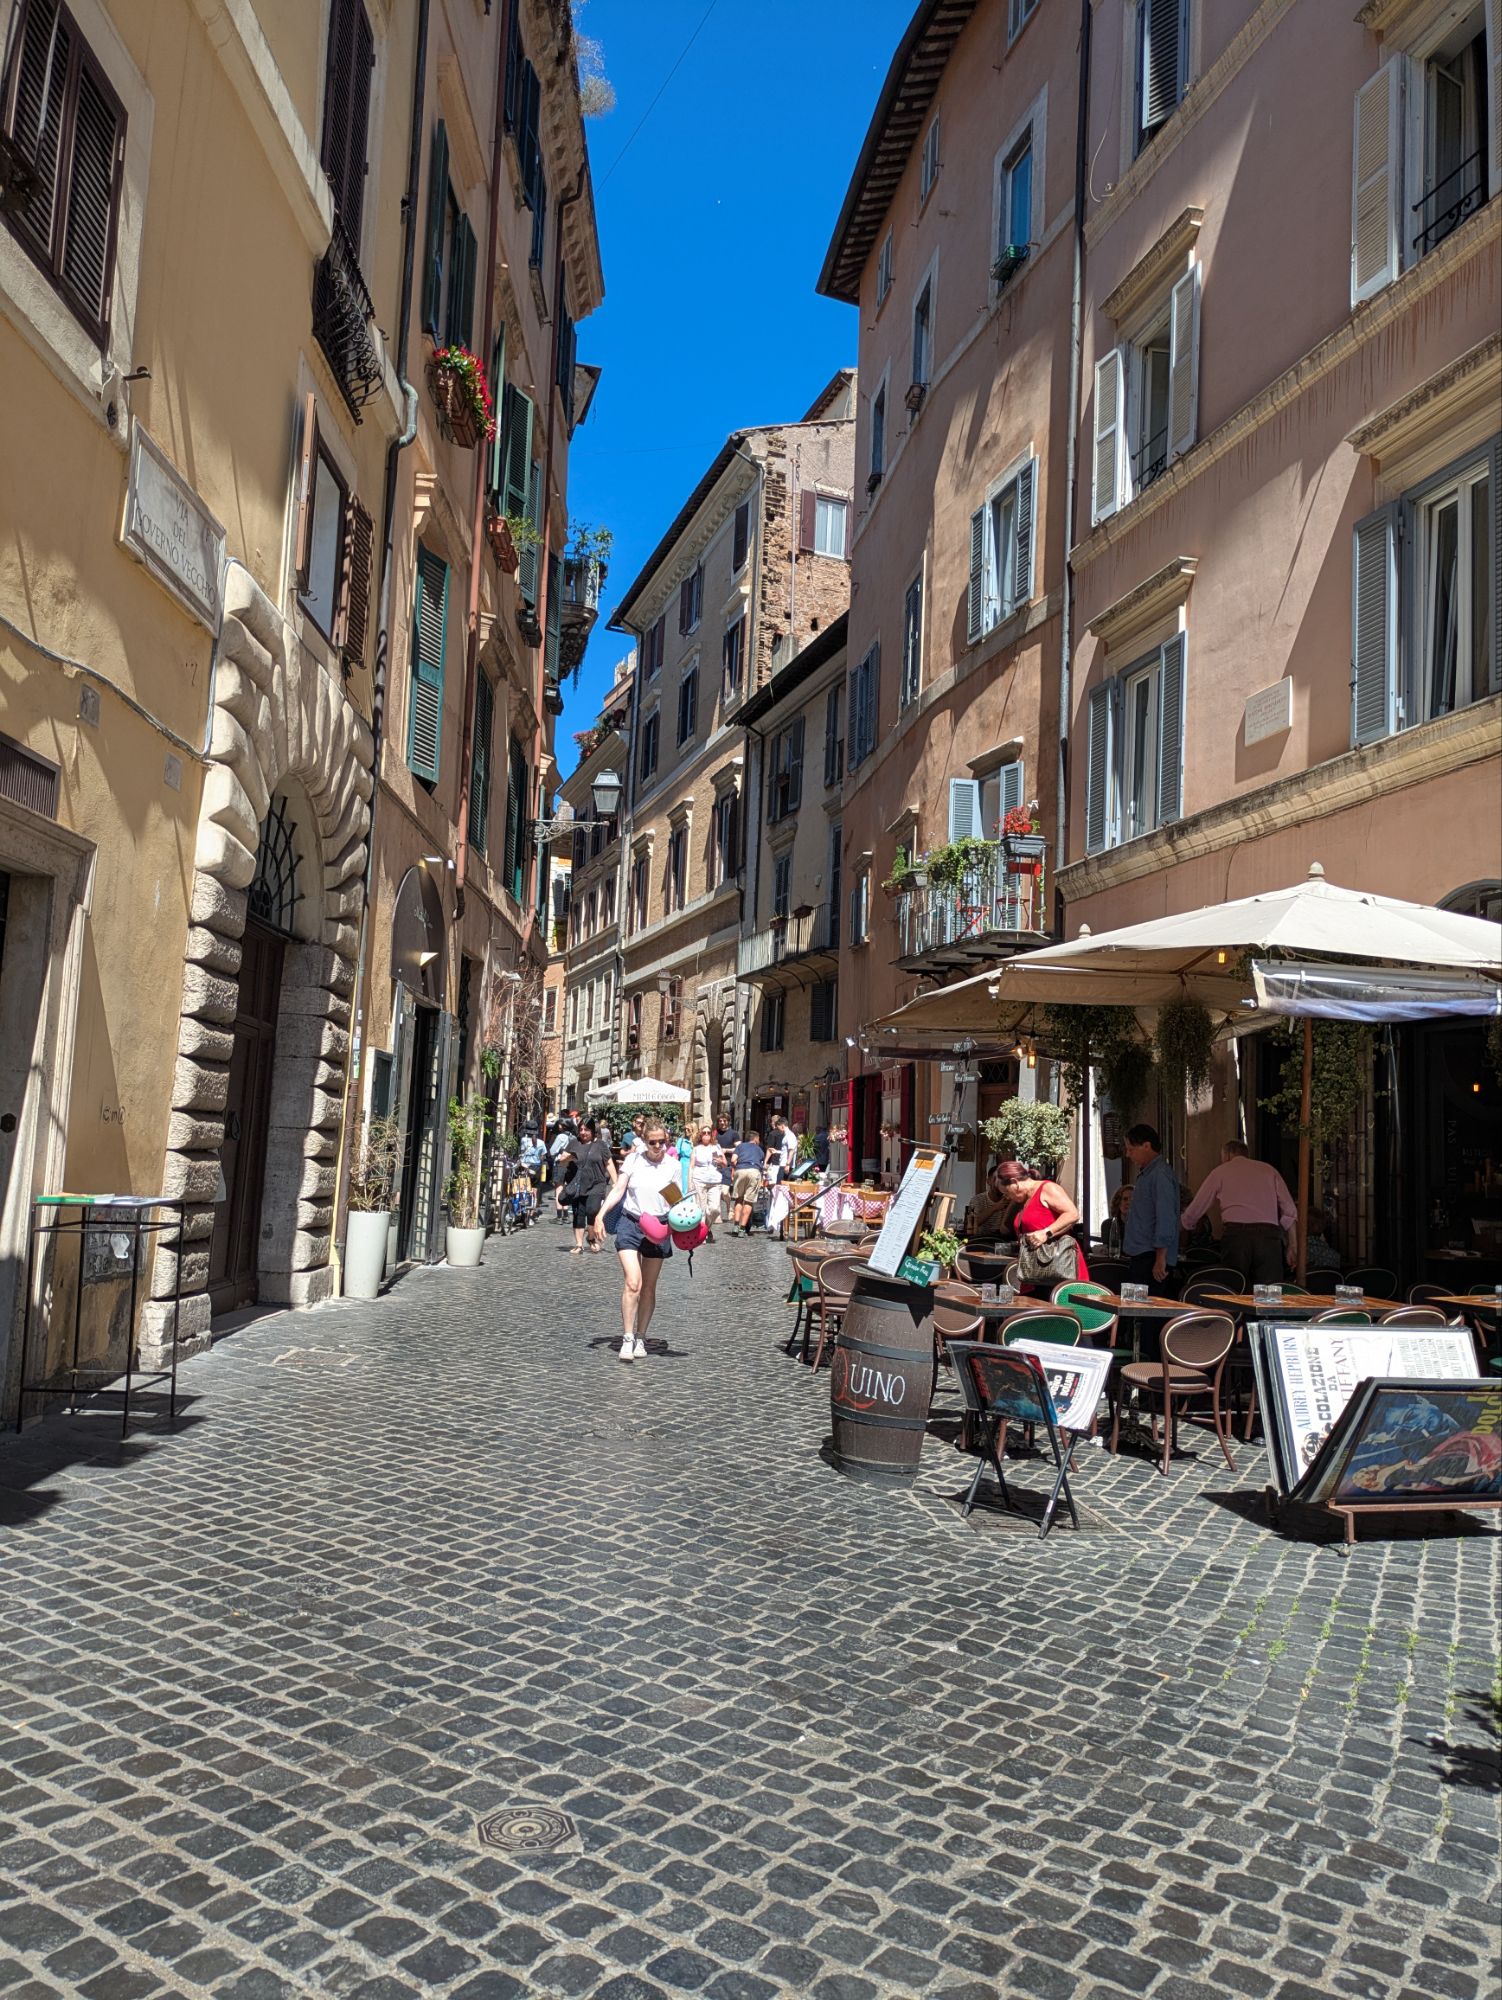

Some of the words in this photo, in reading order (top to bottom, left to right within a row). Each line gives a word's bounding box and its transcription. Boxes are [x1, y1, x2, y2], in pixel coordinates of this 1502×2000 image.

[176, 493, 188, 526] VIA
[136, 506, 180, 565] GOVERNO
[182, 554, 215, 605] VECCHIO
[173, 521, 186, 549] DEL
[1282, 1337, 1303, 1385] HEPBURN
[1329, 1337, 1354, 1405] TIFFANY
[1305, 1346, 1332, 1421] COLAZIONE
[1327, 1375, 1338, 1392] DA
[1292, 1389, 1312, 1430] AUDREY
